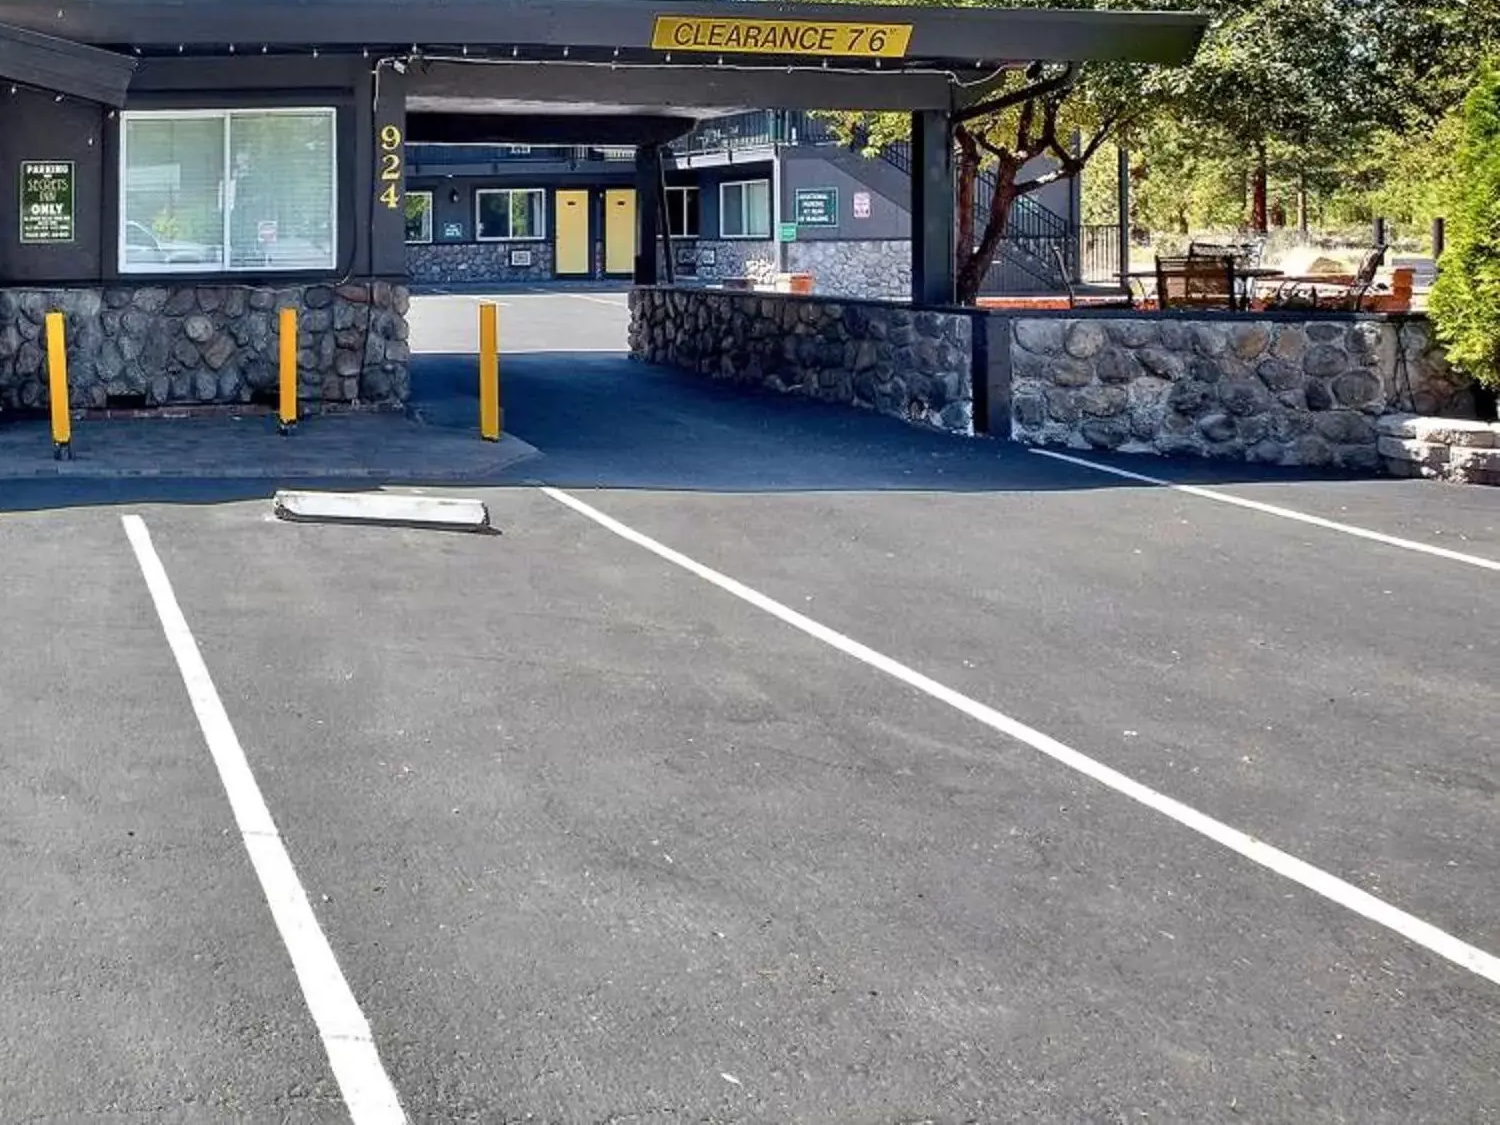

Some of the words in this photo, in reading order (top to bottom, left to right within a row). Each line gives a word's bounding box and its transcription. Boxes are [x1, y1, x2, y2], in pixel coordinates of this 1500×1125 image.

[674, 23, 836, 51] CLEARANCE
[26, 165, 68, 174] PARKING
[380, 124, 401, 209] 924
[31, 203, 64, 215] ONLY
